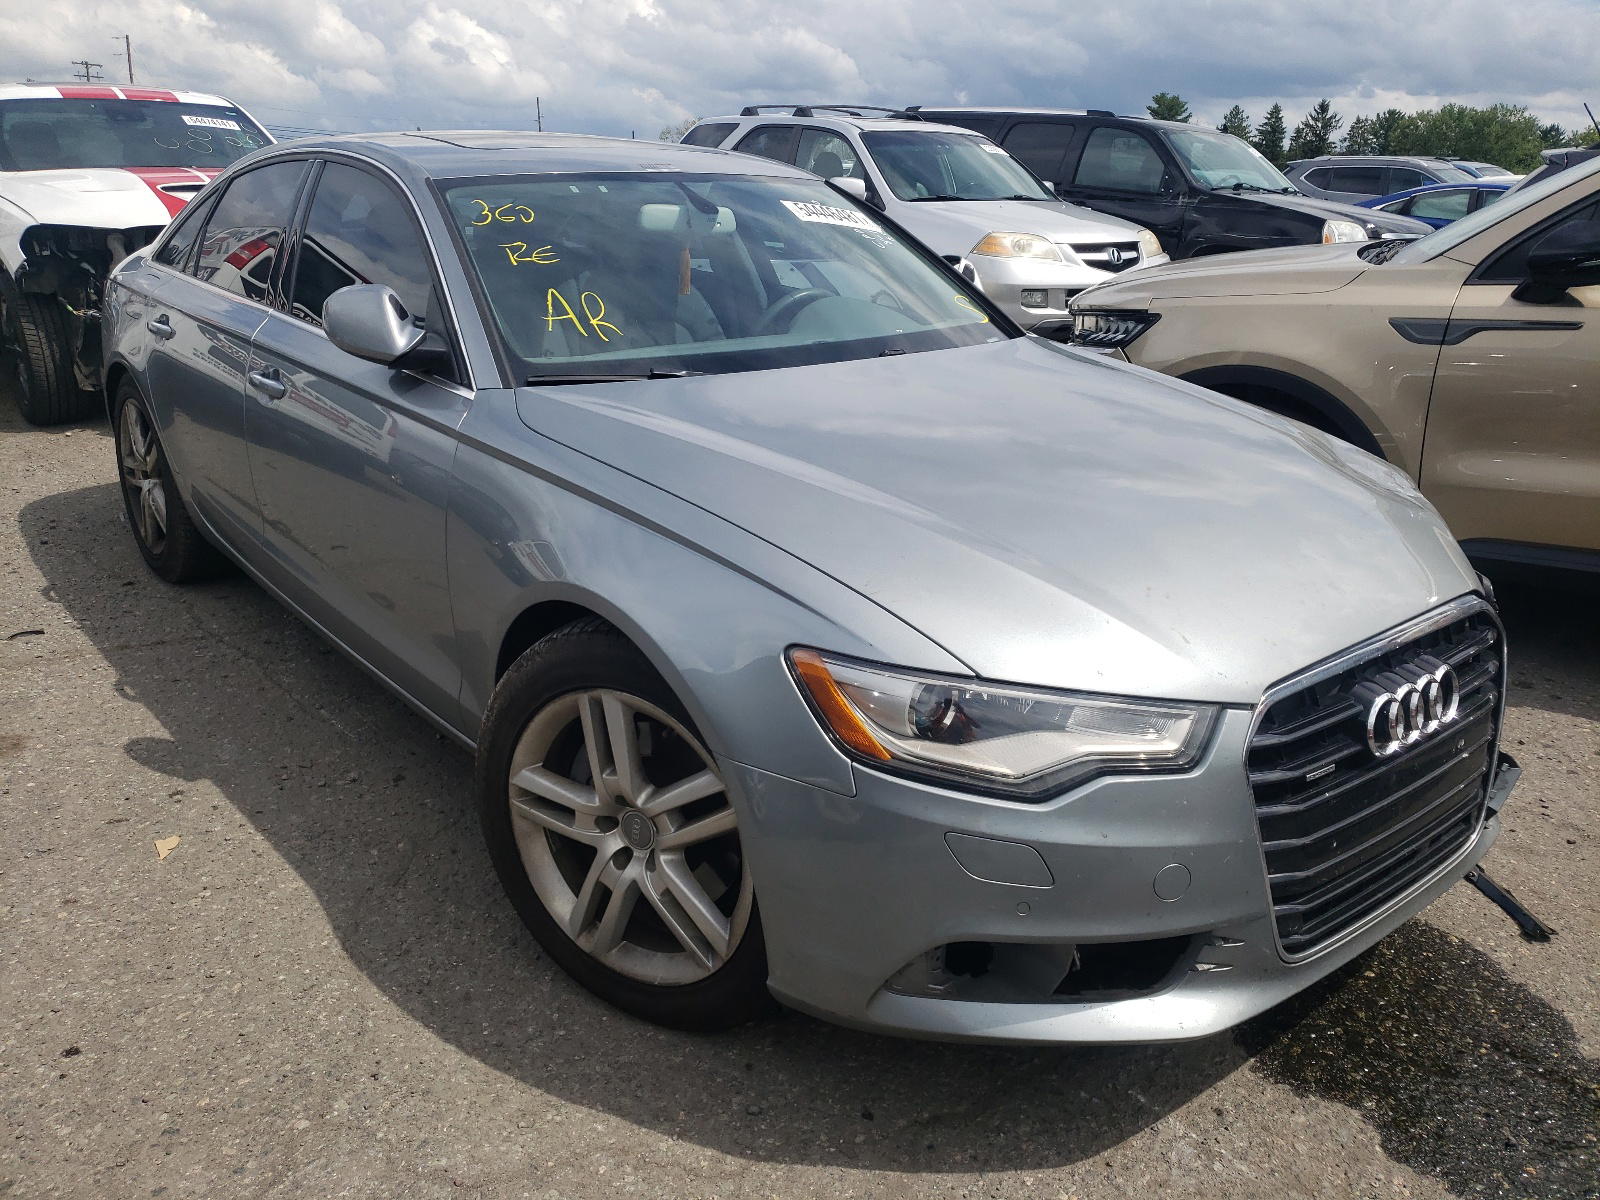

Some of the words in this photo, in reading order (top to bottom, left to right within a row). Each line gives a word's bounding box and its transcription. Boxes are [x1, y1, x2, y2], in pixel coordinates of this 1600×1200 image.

[470, 199, 535, 226] 360
[497, 241, 561, 266] RE
[541, 287, 624, 342] AR
